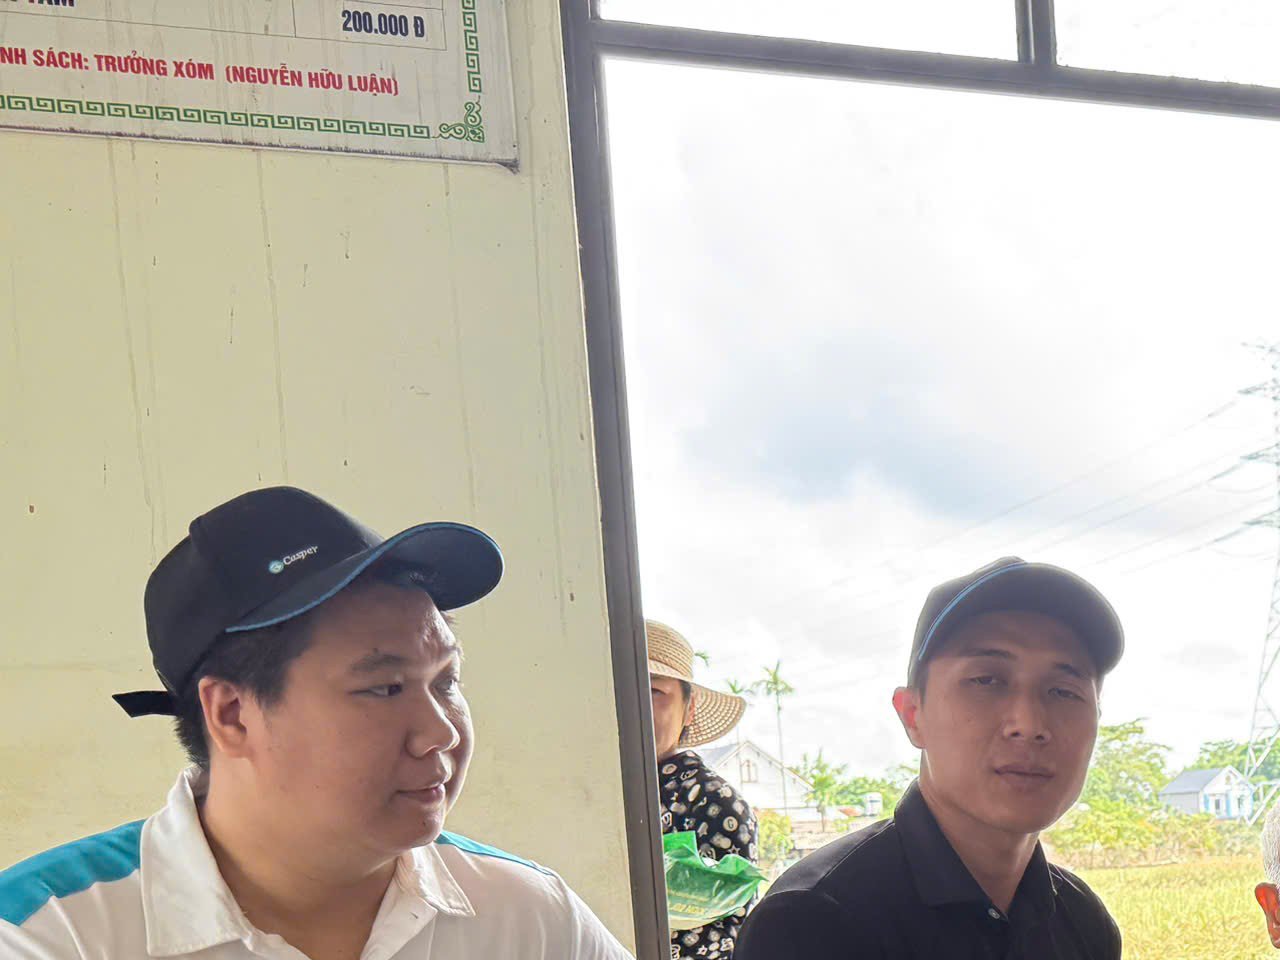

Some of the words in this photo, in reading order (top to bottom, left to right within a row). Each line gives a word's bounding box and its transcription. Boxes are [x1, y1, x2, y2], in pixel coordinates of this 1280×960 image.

[341, 9, 410, 37] 200.000
[413, 14, 425, 38] Đ
[32, 47, 89, 70] SÁCH:
[94, 50, 168, 77] TRƯỞNG
[173, 58, 215, 81] XÓM
[225, 62, 303, 88] (NGUYỄN
[308, 70, 343, 91] HỮU
[348, 73, 399, 98] LUẬN)
